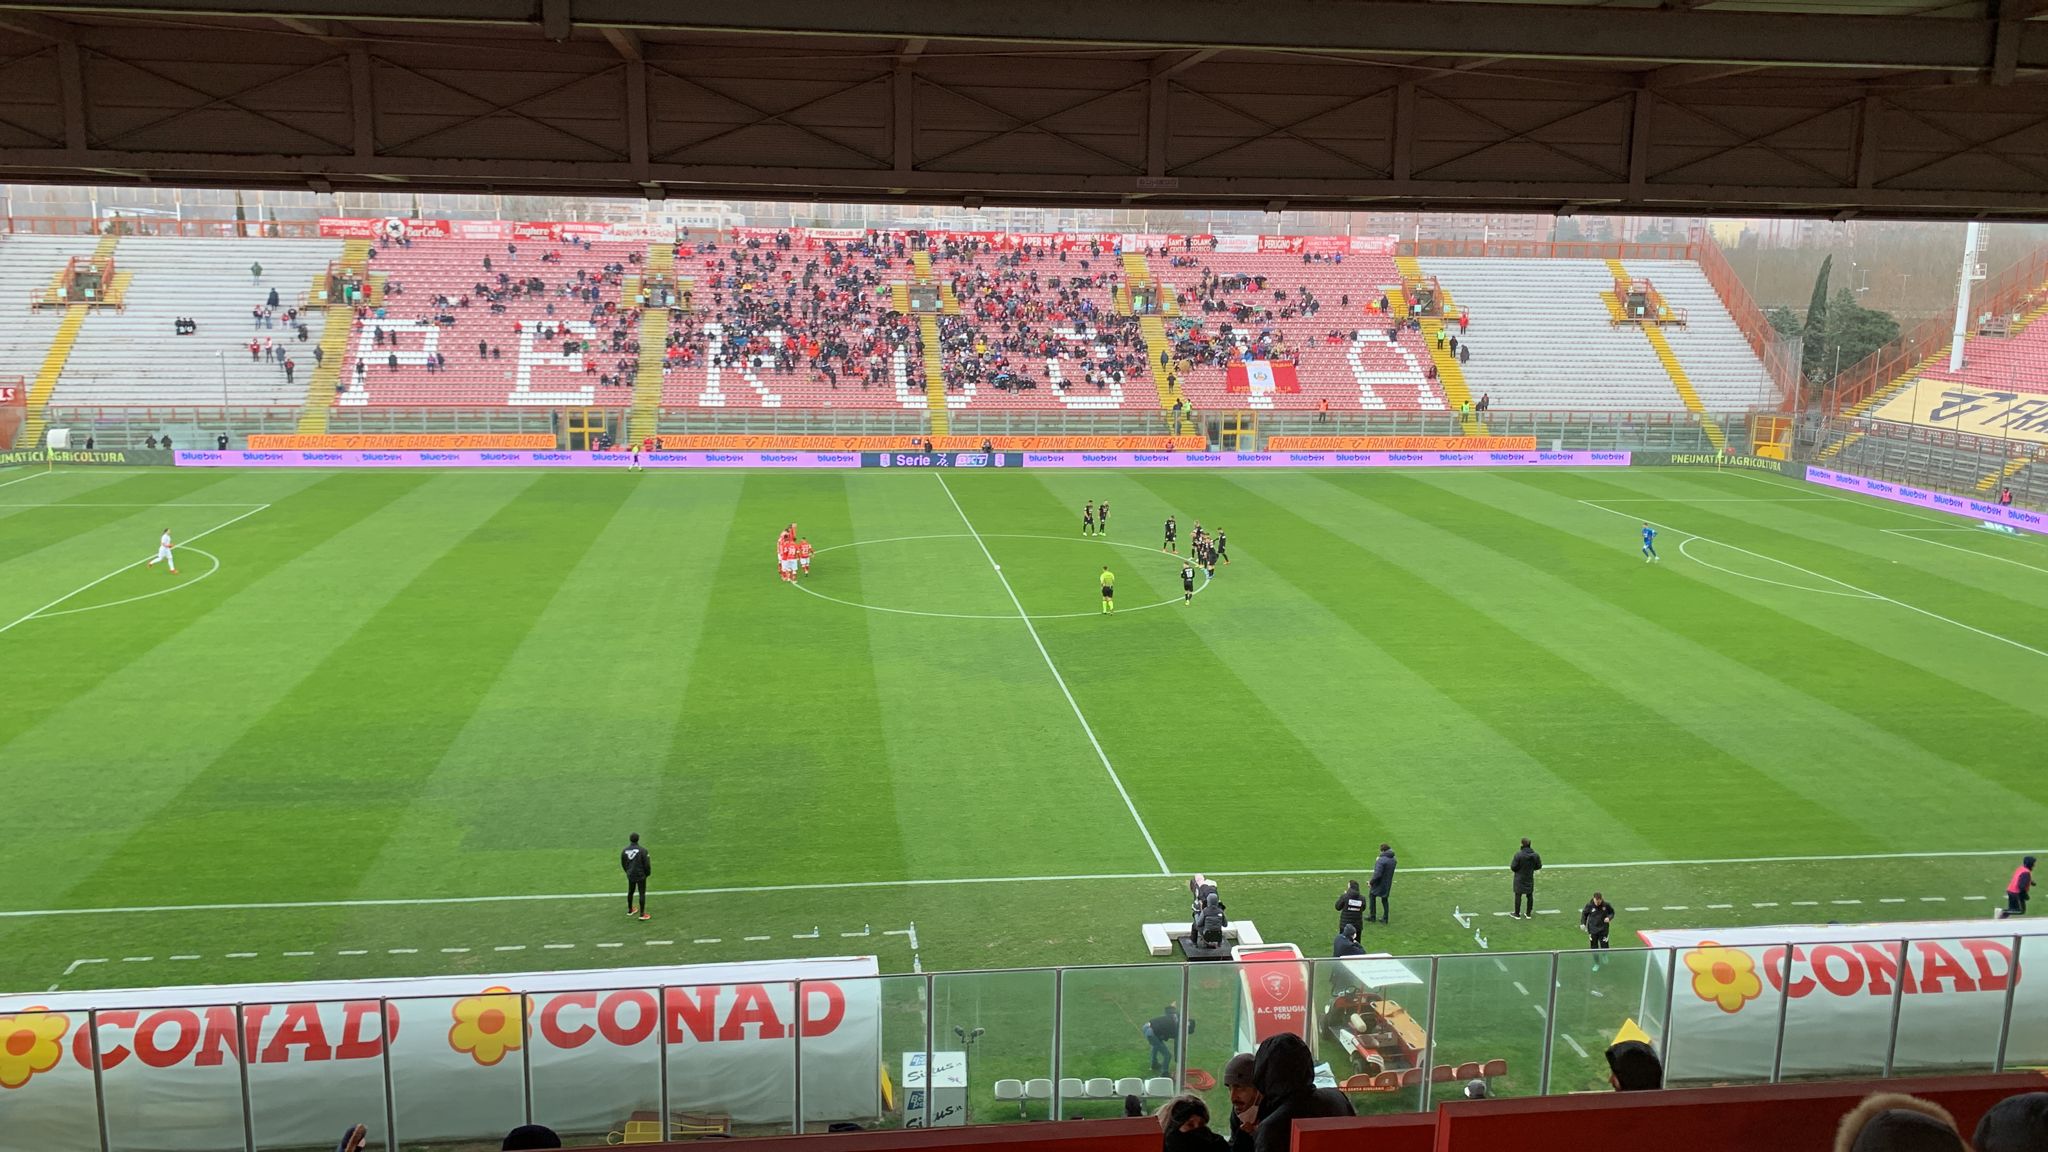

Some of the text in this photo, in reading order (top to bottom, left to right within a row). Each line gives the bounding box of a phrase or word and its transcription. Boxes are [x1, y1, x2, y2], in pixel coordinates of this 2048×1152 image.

[896, 454, 930, 466] Serie
[1671, 454, 1782, 472] PNEUMATICI AGRICOLTURA
[1763, 939, 2022, 998] CONAD
[540, 980, 846, 1049] CONAD
[1257, 1005, 1306, 1014] A.C. PERUGIA
[72, 1000, 400, 1071] CONAD
